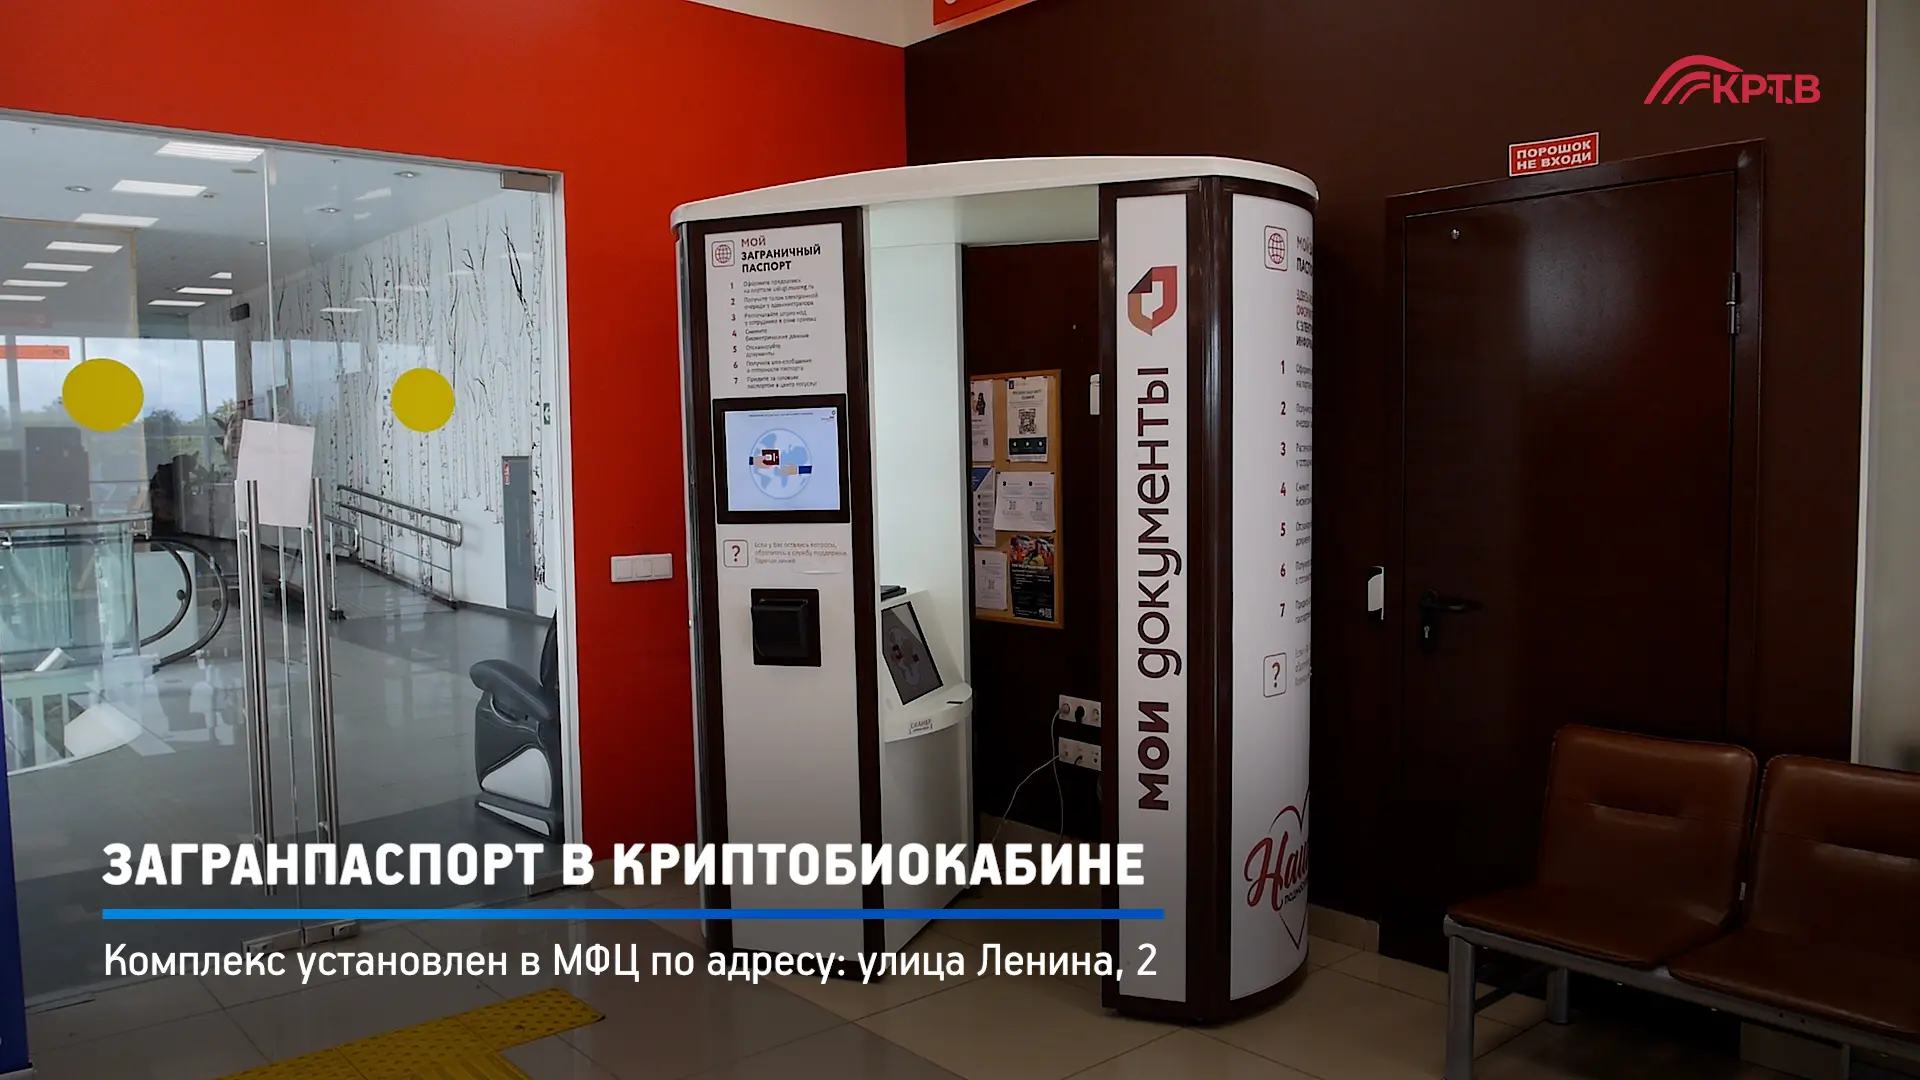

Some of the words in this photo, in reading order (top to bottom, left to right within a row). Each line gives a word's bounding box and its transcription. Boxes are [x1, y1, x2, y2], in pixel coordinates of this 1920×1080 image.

[1516, 140, 1592, 159] ПОРОШОК
[1516, 159, 1537, 171] НЕ
[1541, 152, 1592, 167] ВХОДИ
[741, 235, 766, 248] МОЙ
[741, 243, 821, 261] ЗАГРАНИЧНЫЙ
[742, 261, 792, 273] ПАСПОРТ
[731, 298, 735, 306] 2
[733, 345, 738, 353] 5
[733, 361, 738, 369] 6
[1280, 360, 1285, 374] 1
[1280, 401, 1286, 415] 2
[1280, 442, 1286, 456] 3
[1280, 482, 1286, 496] 4
[1137, 366, 1182, 680] документы
[1280, 522, 1286, 537] 5
[1280, 563, 1286, 577] 6
[1280, 603, 1286, 617] 7
